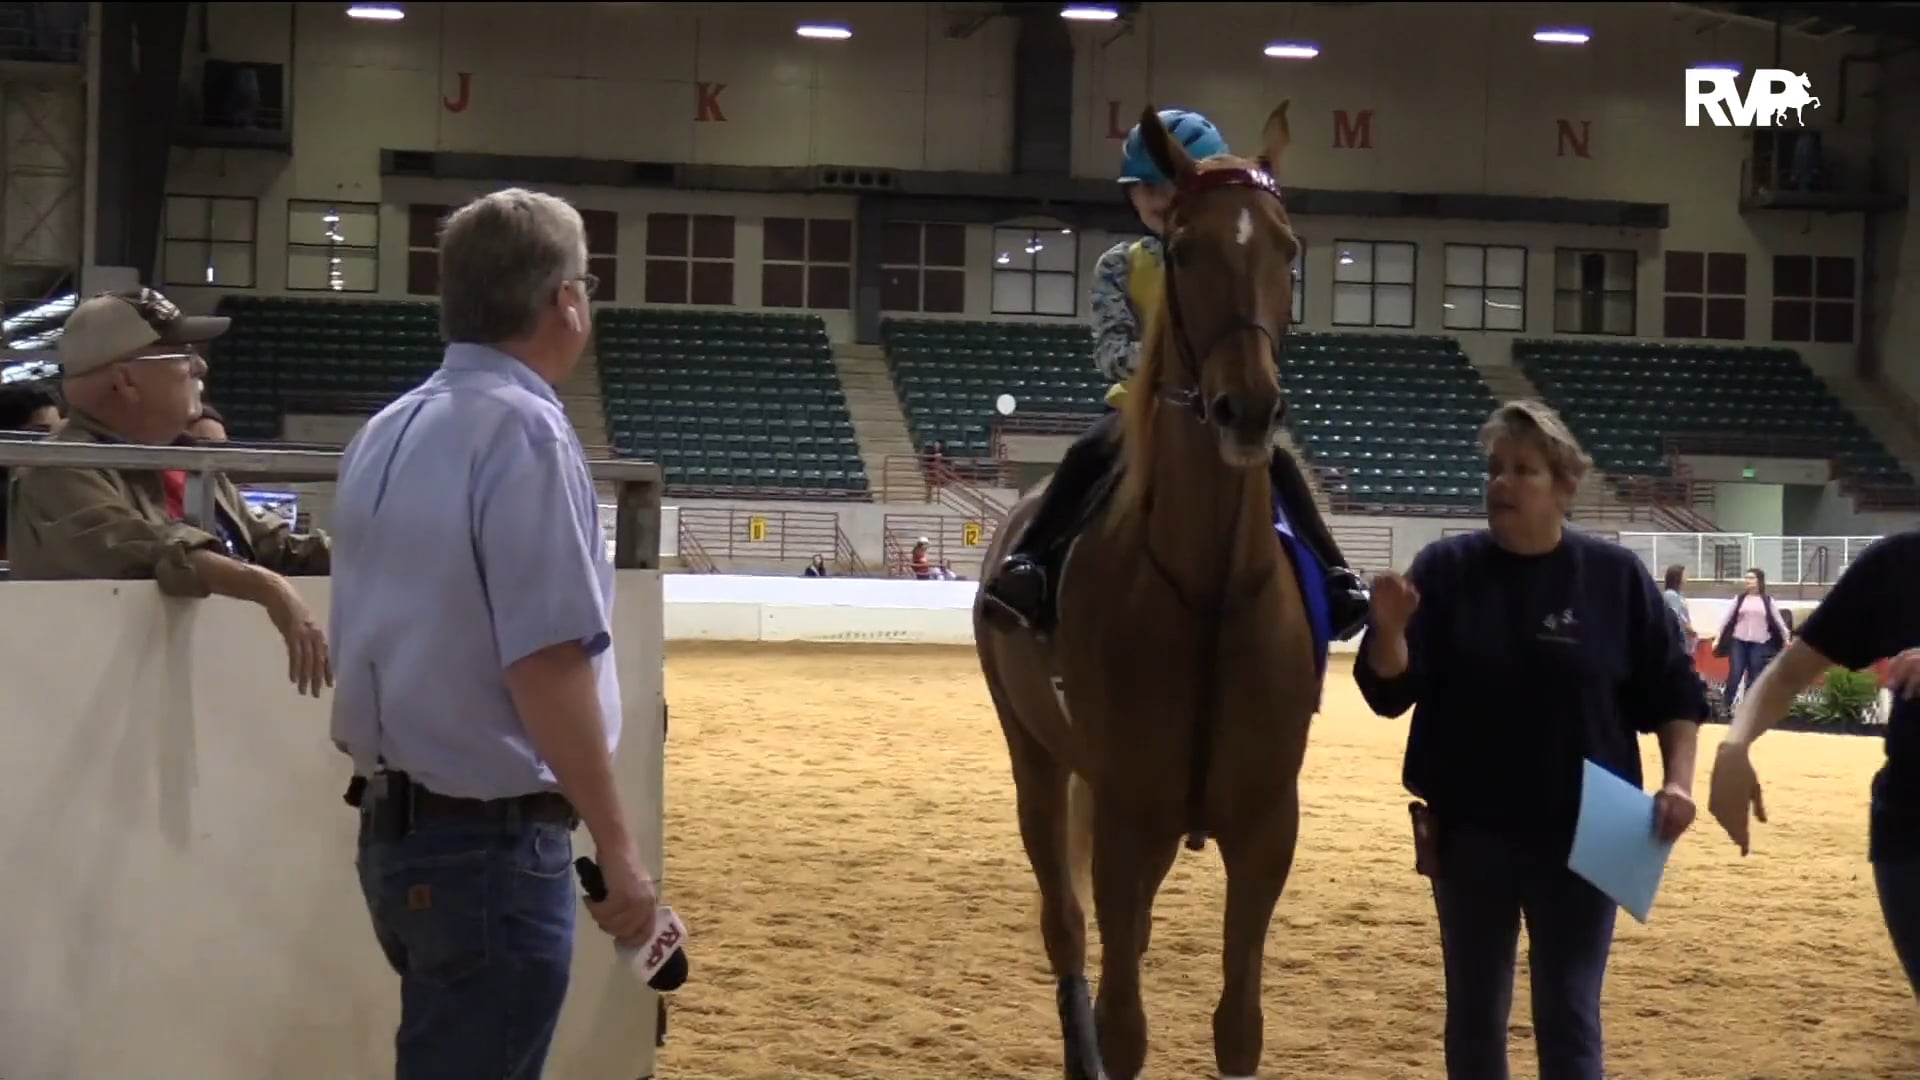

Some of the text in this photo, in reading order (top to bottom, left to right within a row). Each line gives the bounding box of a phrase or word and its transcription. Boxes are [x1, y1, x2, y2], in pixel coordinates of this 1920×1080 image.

[443, 72, 472, 113] J
[693, 81, 728, 122] K
[1105, 100, 1128, 139] L
[1332, 109, 1375, 149] M
[1556, 118, 1592, 159] N
[966, 530, 977, 546] 12
[644, 922, 681, 971] RVP
